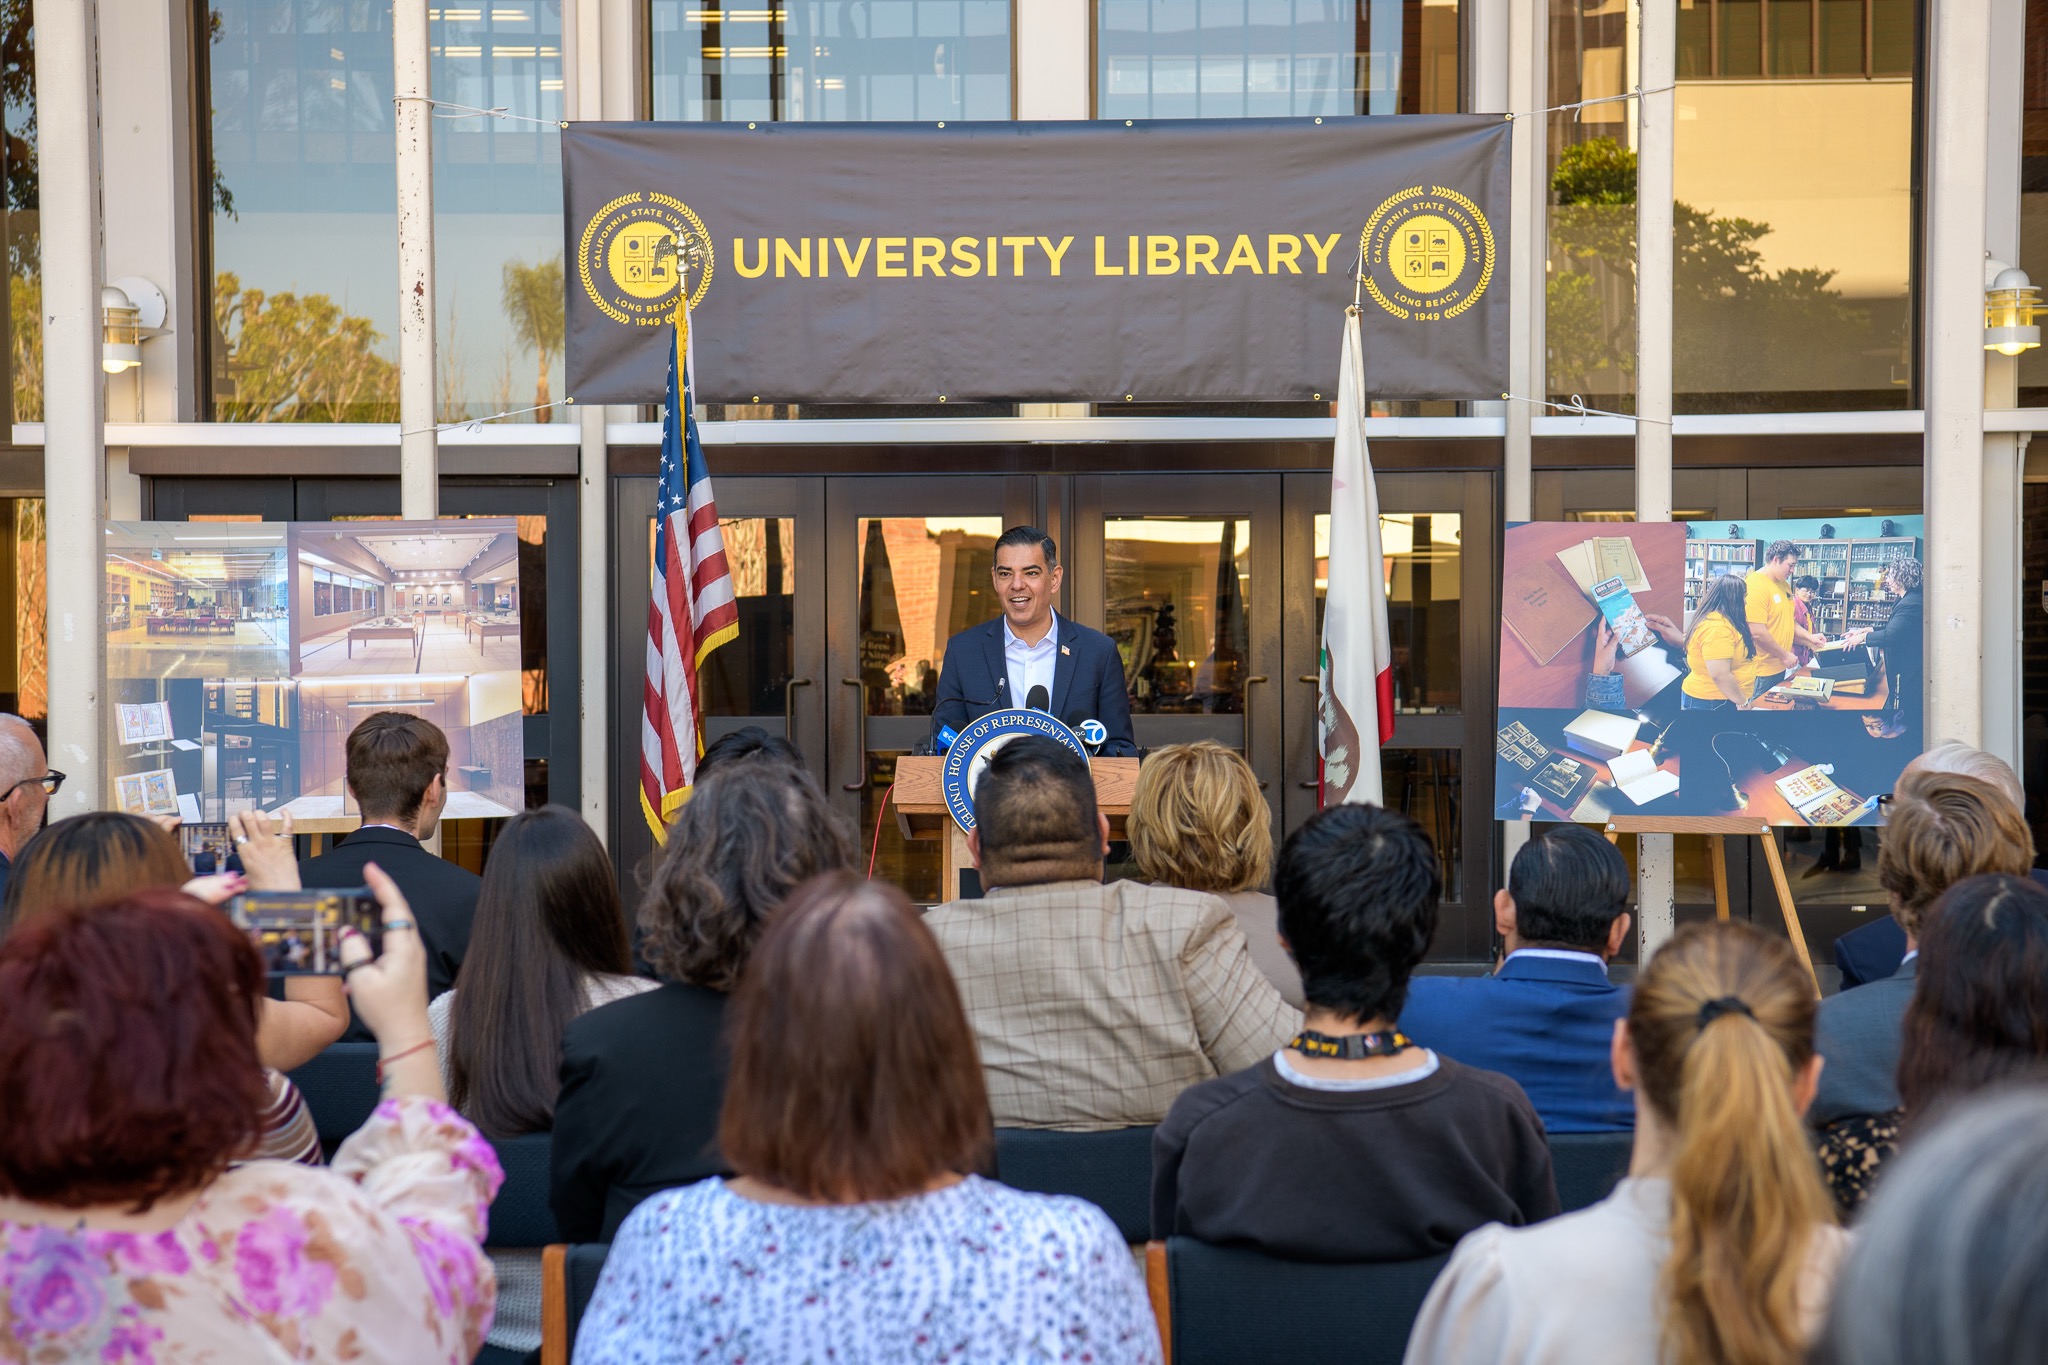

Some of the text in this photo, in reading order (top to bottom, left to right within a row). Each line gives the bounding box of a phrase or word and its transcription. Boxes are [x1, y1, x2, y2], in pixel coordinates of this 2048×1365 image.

[594, 213, 629, 269] CALIFORNIA
[631, 208, 663, 218] STATE
[1373, 202, 1481, 264] CALIFORNIA STATE UNIVERSITY
[733, 234, 1342, 279] UNIVERSITY LIBRARY
[614, 295, 681, 313] LONG BEACH
[1394, 289, 1460, 308] LONG BEACH
[1414, 312, 1440, 321] 1949
[635, 317, 661, 326] 1949
[948, 735, 976, 777] HOUSE
[973, 722, 990, 738] OF
[948, 782, 977, 829] UNITED
